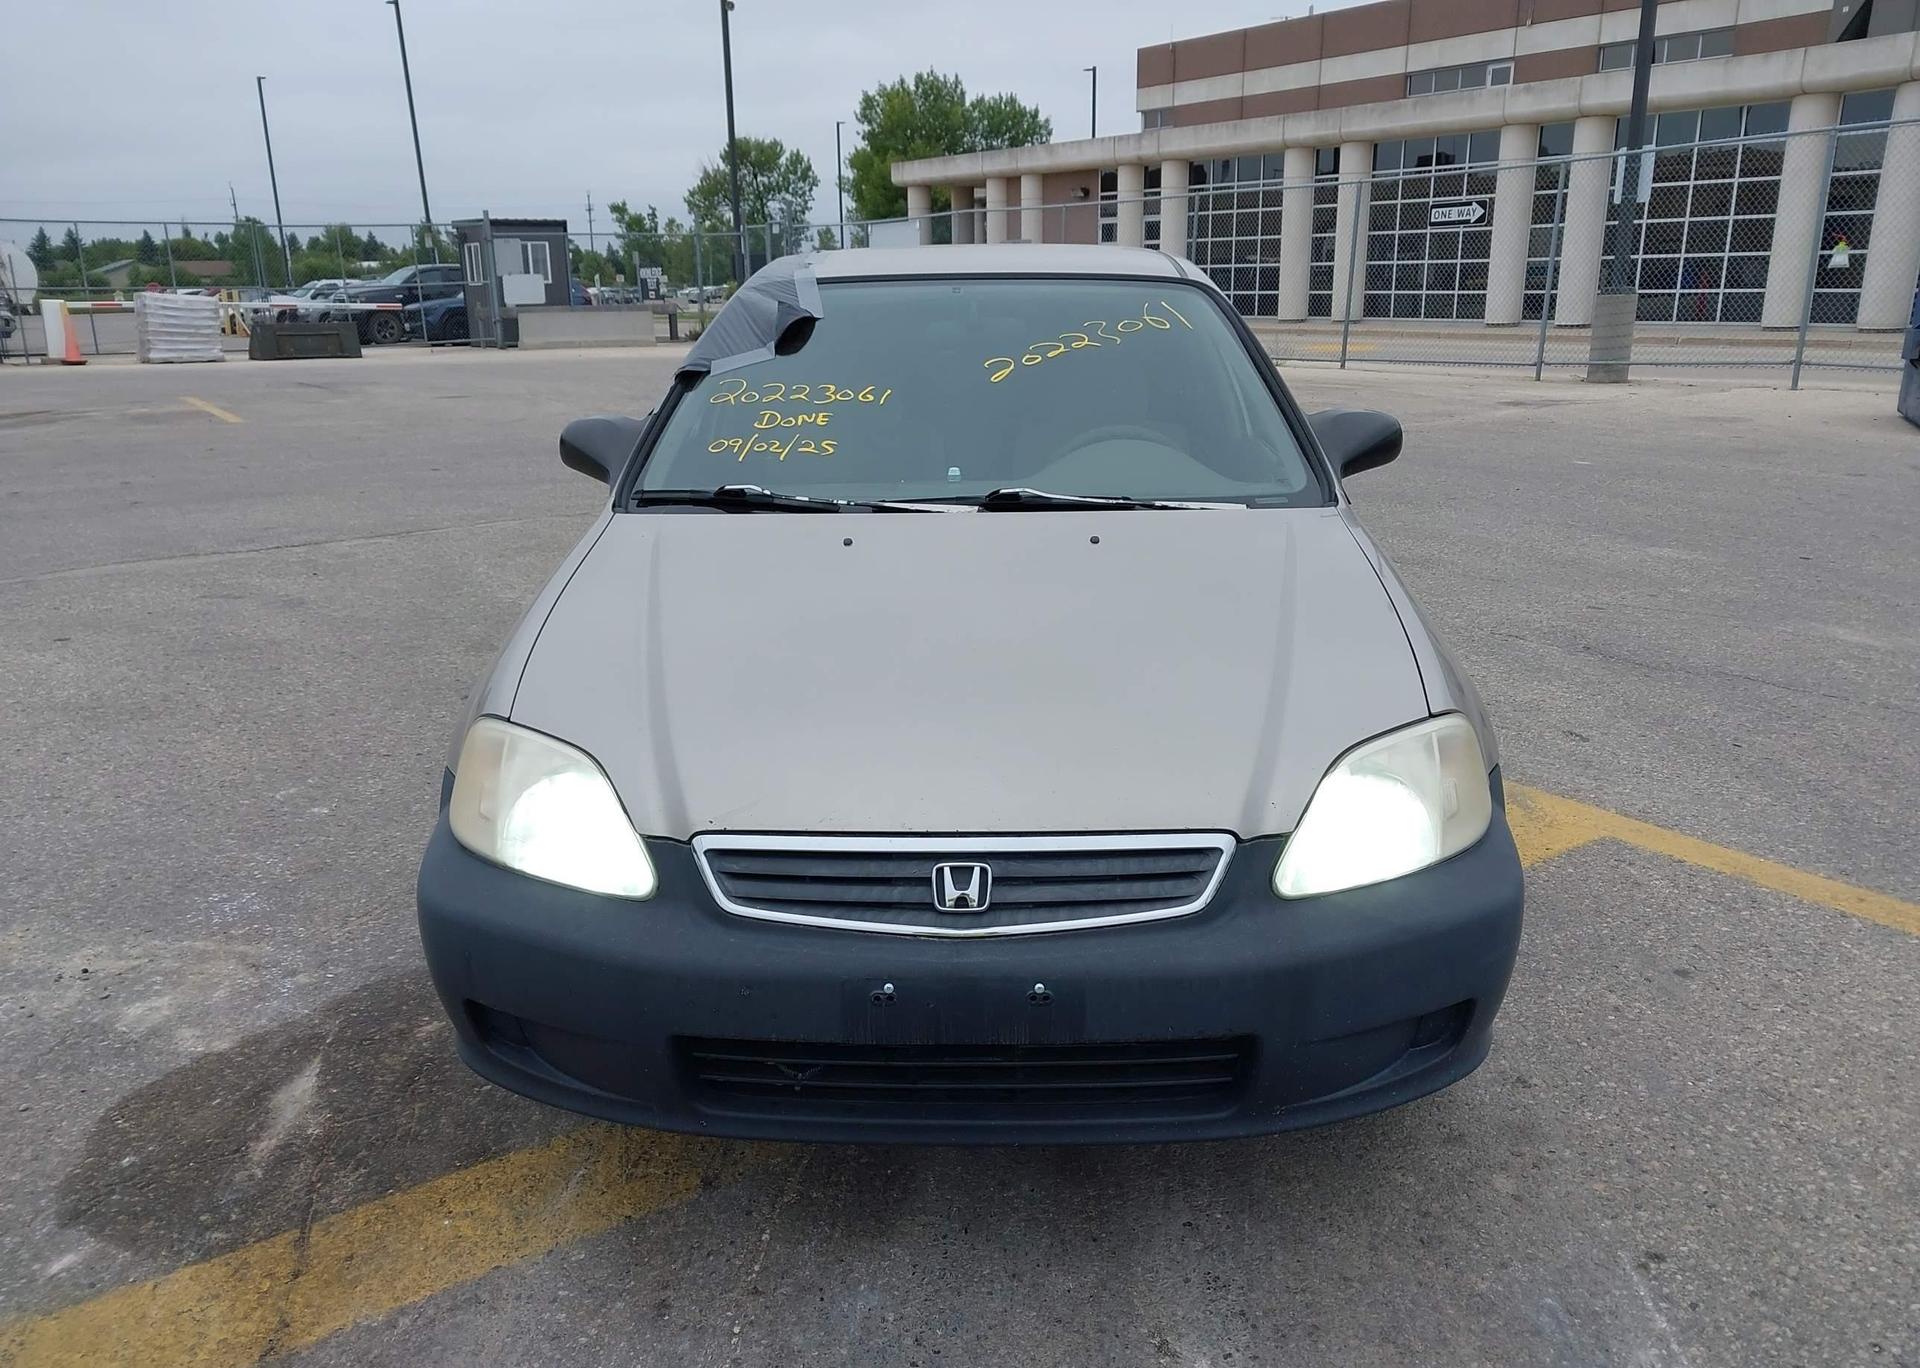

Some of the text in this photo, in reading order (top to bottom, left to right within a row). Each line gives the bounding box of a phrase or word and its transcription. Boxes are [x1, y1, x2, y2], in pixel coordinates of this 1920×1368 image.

[1433, 207, 1477, 220] ONE WAY
[984, 300, 1194, 383] 20223061
[709, 378, 892, 406] 20223061
[753, 410, 834, 429] DONE
[708, 433, 839, 462] 09/02/25
